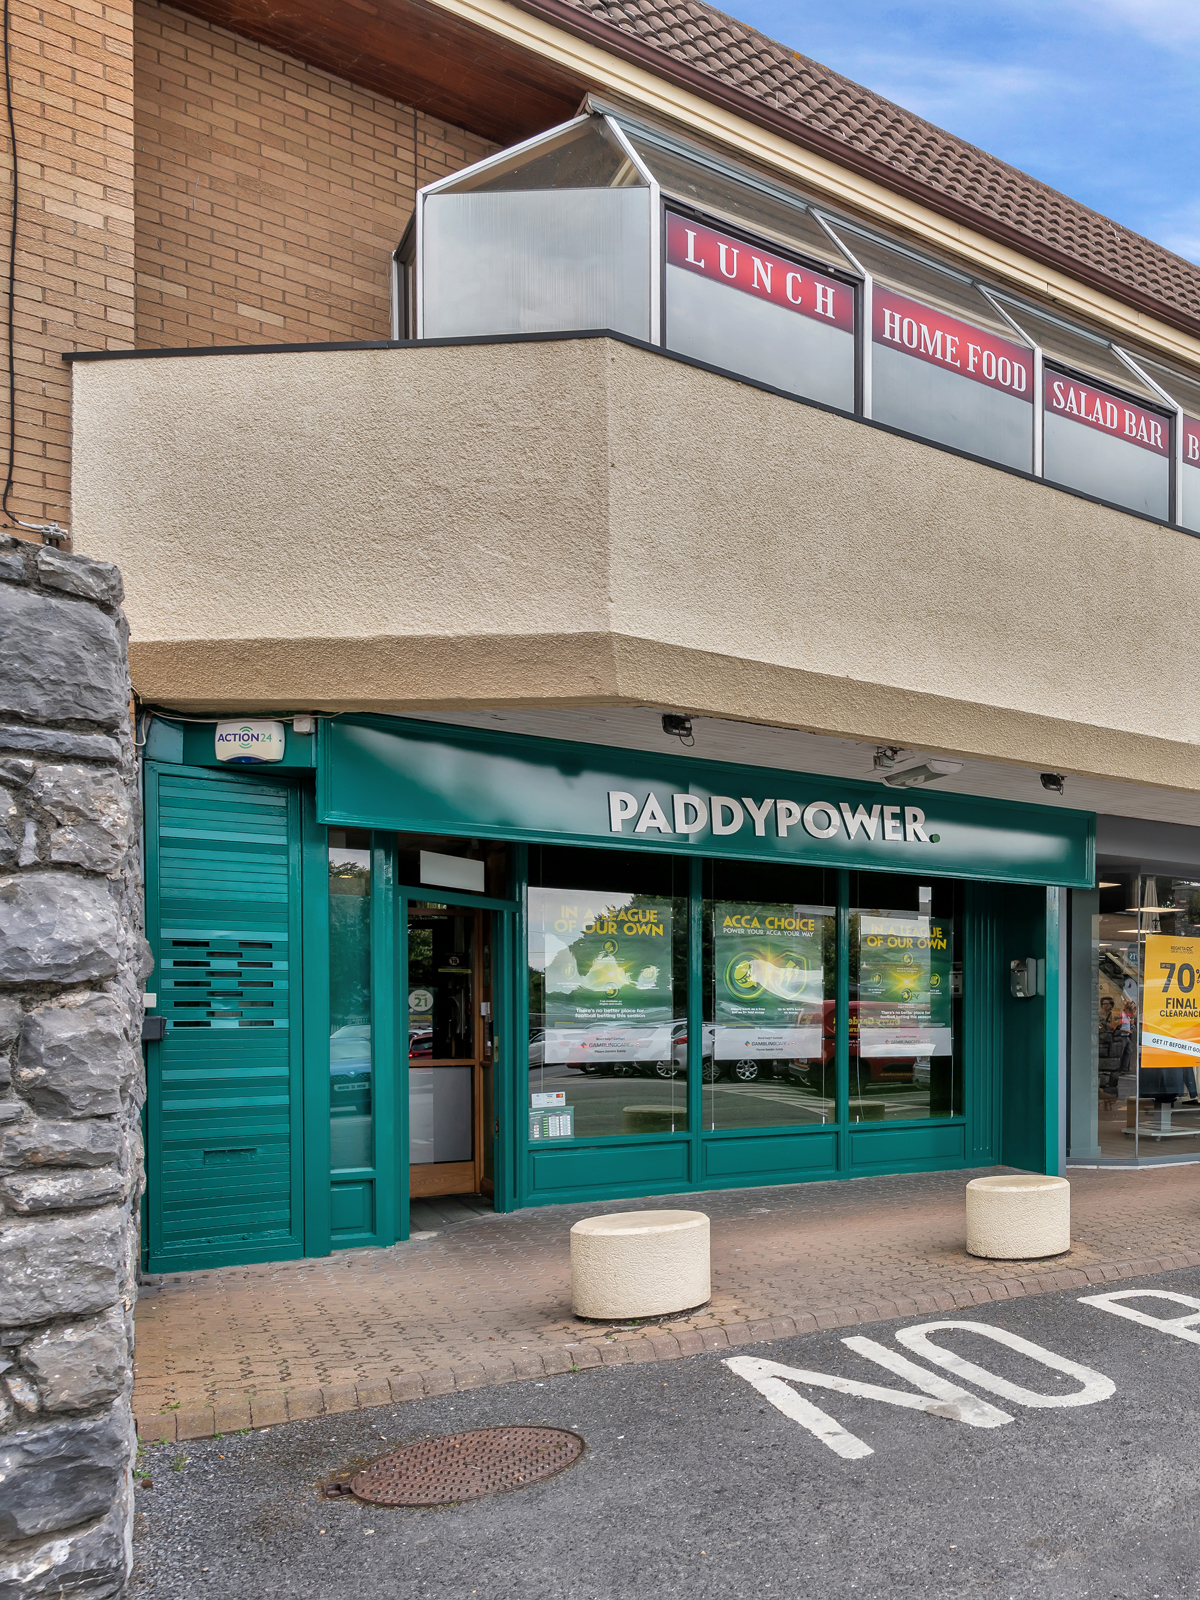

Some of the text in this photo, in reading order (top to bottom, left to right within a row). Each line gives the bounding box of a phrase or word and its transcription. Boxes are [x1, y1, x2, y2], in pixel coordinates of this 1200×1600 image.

[685, 229, 836, 319] LUNCH
[882, 308, 1026, 393] HOME FOOD
[1052, 381, 1163, 449] SALAD BAR
[561, 905, 658, 923] IN A LEAGUE
[554, 920, 664, 936] OF OUR OWN
[723, 915, 815, 931] ACCA CHOICE
[871, 924, 942, 938] IN A LEAGUE
[867, 936, 947, 949] OF OUR OWN
[414, 997, 428, 1007] 21
[1166, 998, 1197, 1009] FINAL
[1169, 1041, 1187, 1050] BEFORE
[722, 1319, 1116, 1459] NO
